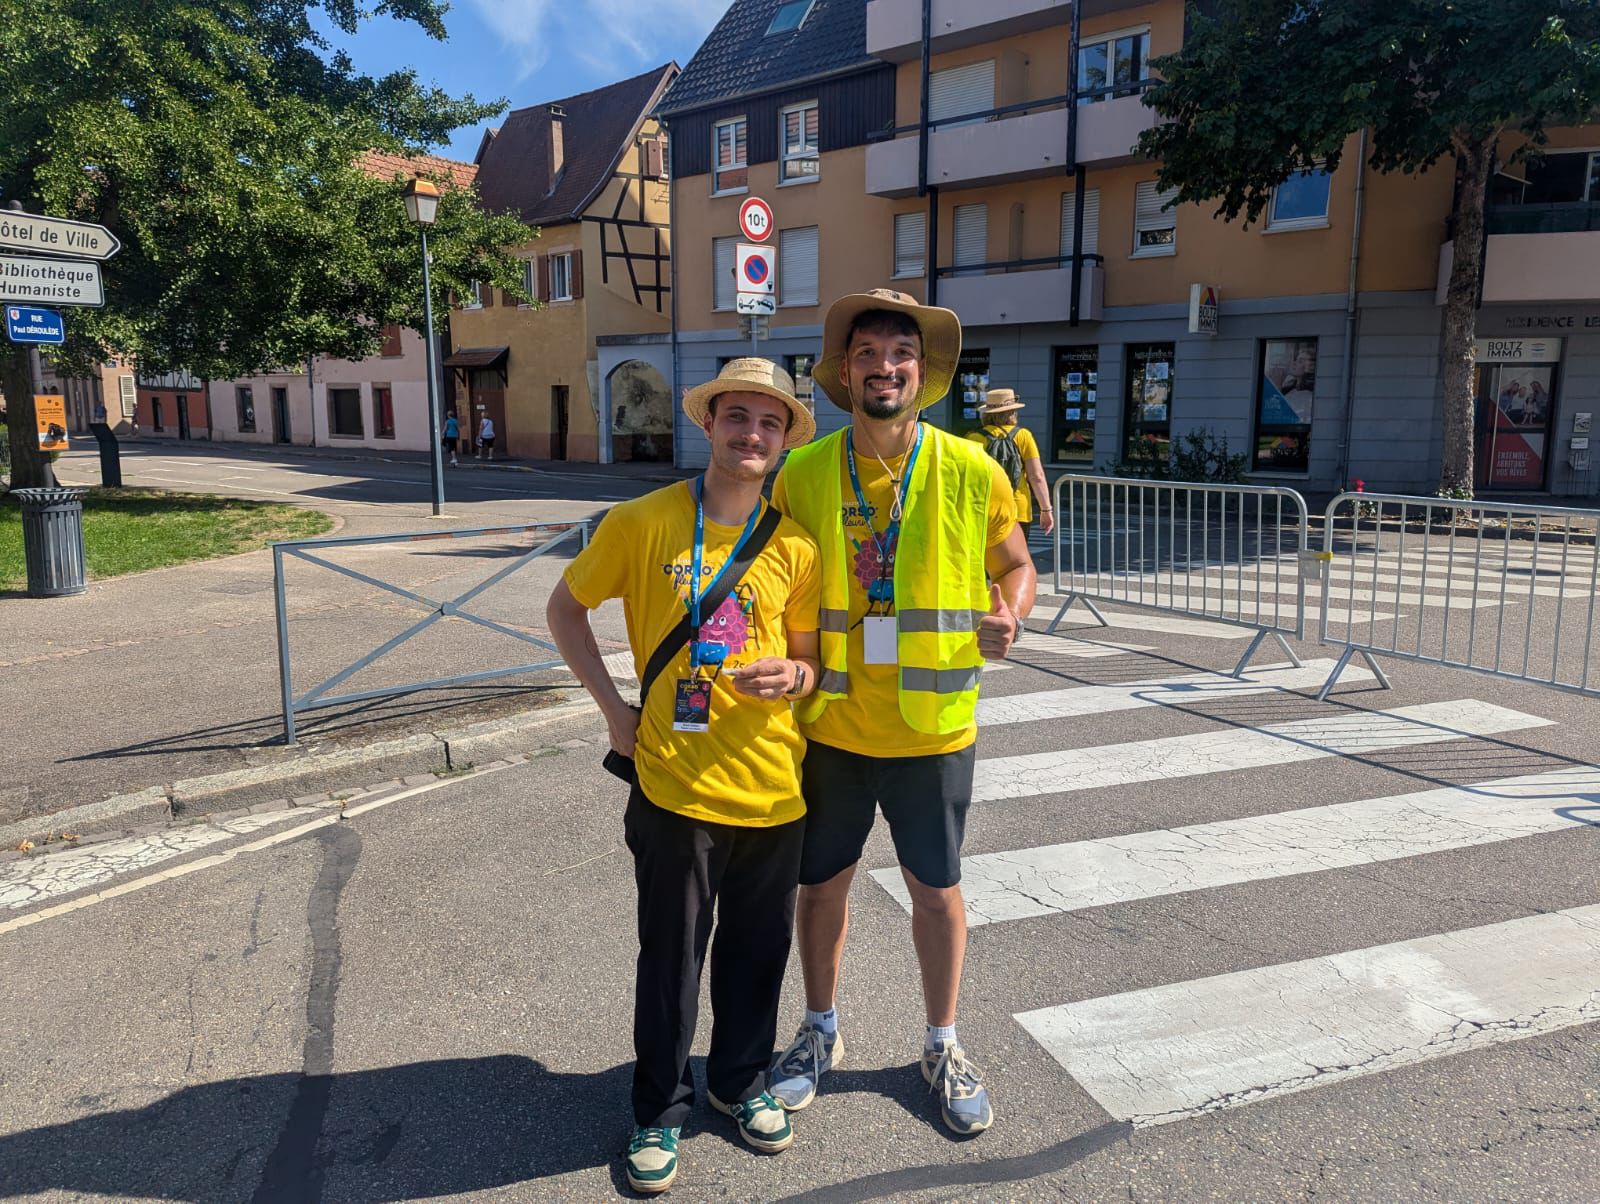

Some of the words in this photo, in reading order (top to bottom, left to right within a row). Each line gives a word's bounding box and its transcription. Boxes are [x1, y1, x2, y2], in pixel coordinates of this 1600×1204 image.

[0, 220, 33, 241] ôtel
[40, 227, 58, 244] de
[66, 230, 98, 249] Ville
[31, 314, 44, 323] RUE
[13, 325, 26, 334] Paul
[1488, 341, 1523, 351] BOLTZ
[1487, 350, 1522, 358] IMMO
[842, 506, 876, 518] ORSO
[663, 563, 713, 577] CORO
